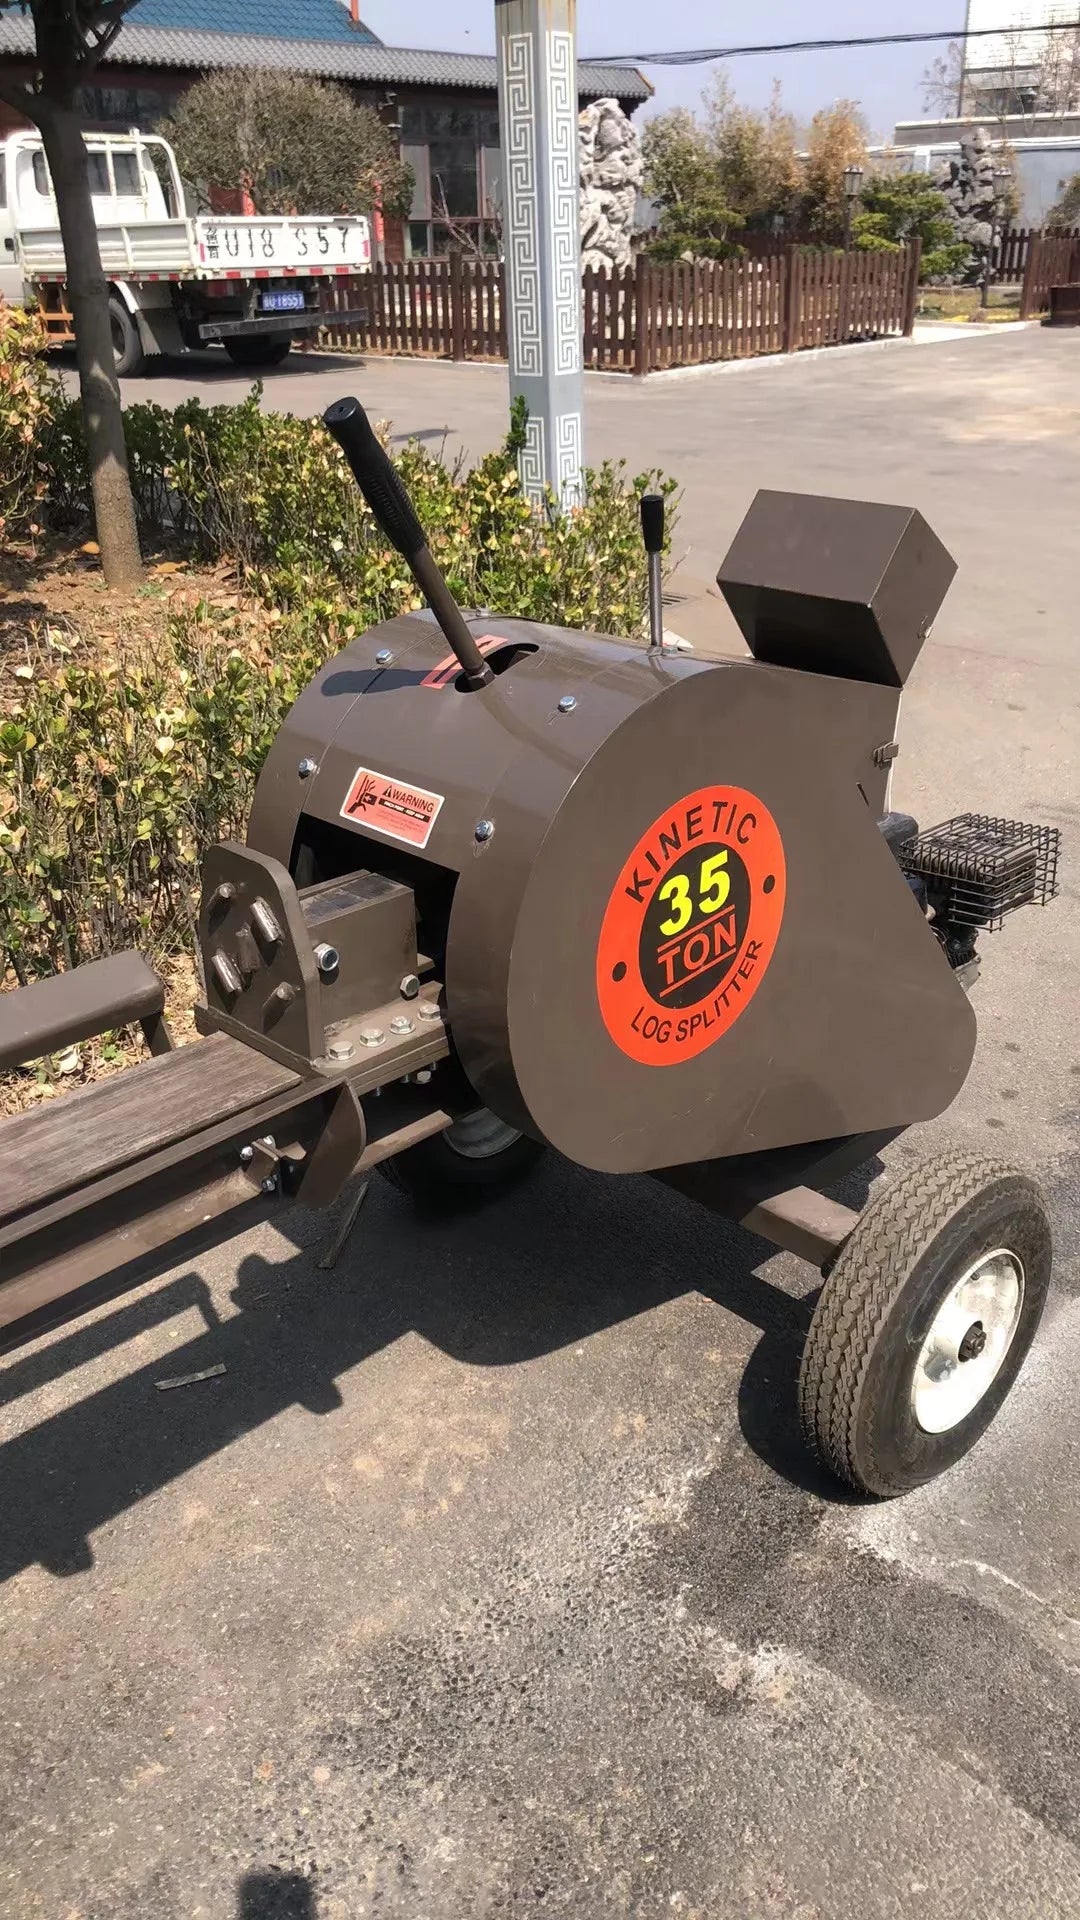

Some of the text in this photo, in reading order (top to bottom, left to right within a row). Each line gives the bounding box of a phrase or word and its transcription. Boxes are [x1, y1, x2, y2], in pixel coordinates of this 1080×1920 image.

[392, 788, 435, 813] WARNING
[625, 800, 757, 904] KINETIC
[658, 849, 731, 937] 35
[630, 939, 763, 1044] LOG SPLITTER
[657, 914, 736, 985] TON
